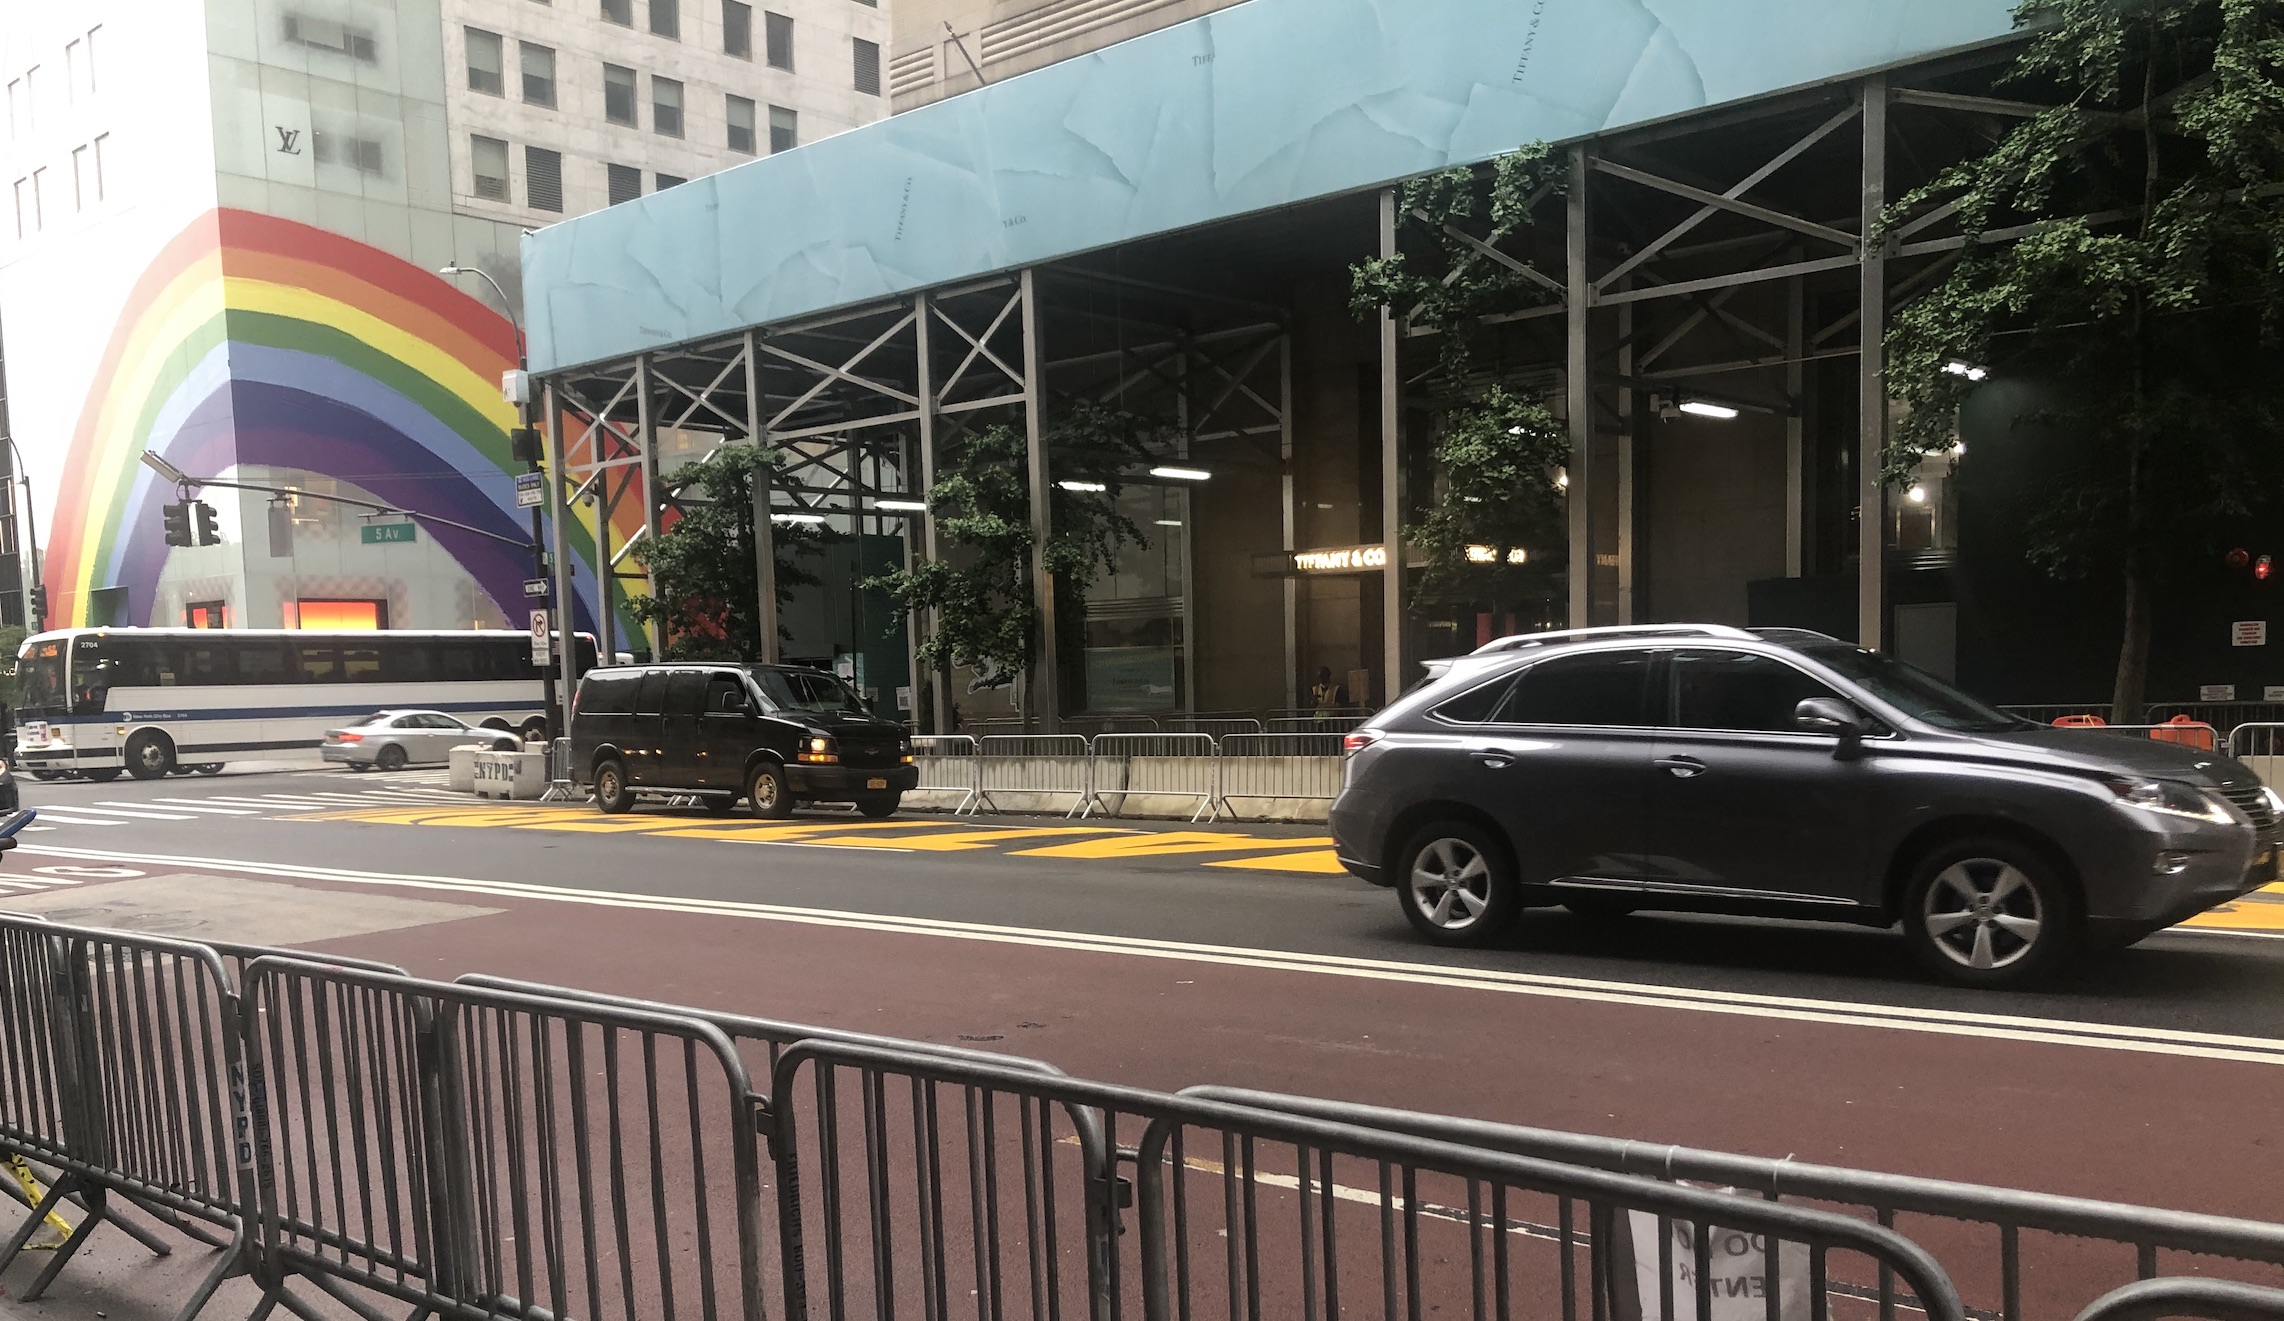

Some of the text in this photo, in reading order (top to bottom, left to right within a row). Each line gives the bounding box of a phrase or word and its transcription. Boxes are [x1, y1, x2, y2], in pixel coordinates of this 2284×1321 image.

[1512, 29, 1536, 84] TIFFANY
[375, 528, 399, 540] 5 Av
[1294, 551, 1351, 570] TIFFANY
[1351, 549, 1362, 567] &
[80, 641, 98, 649] 2704
[479, 761, 509, 781] NYPD
